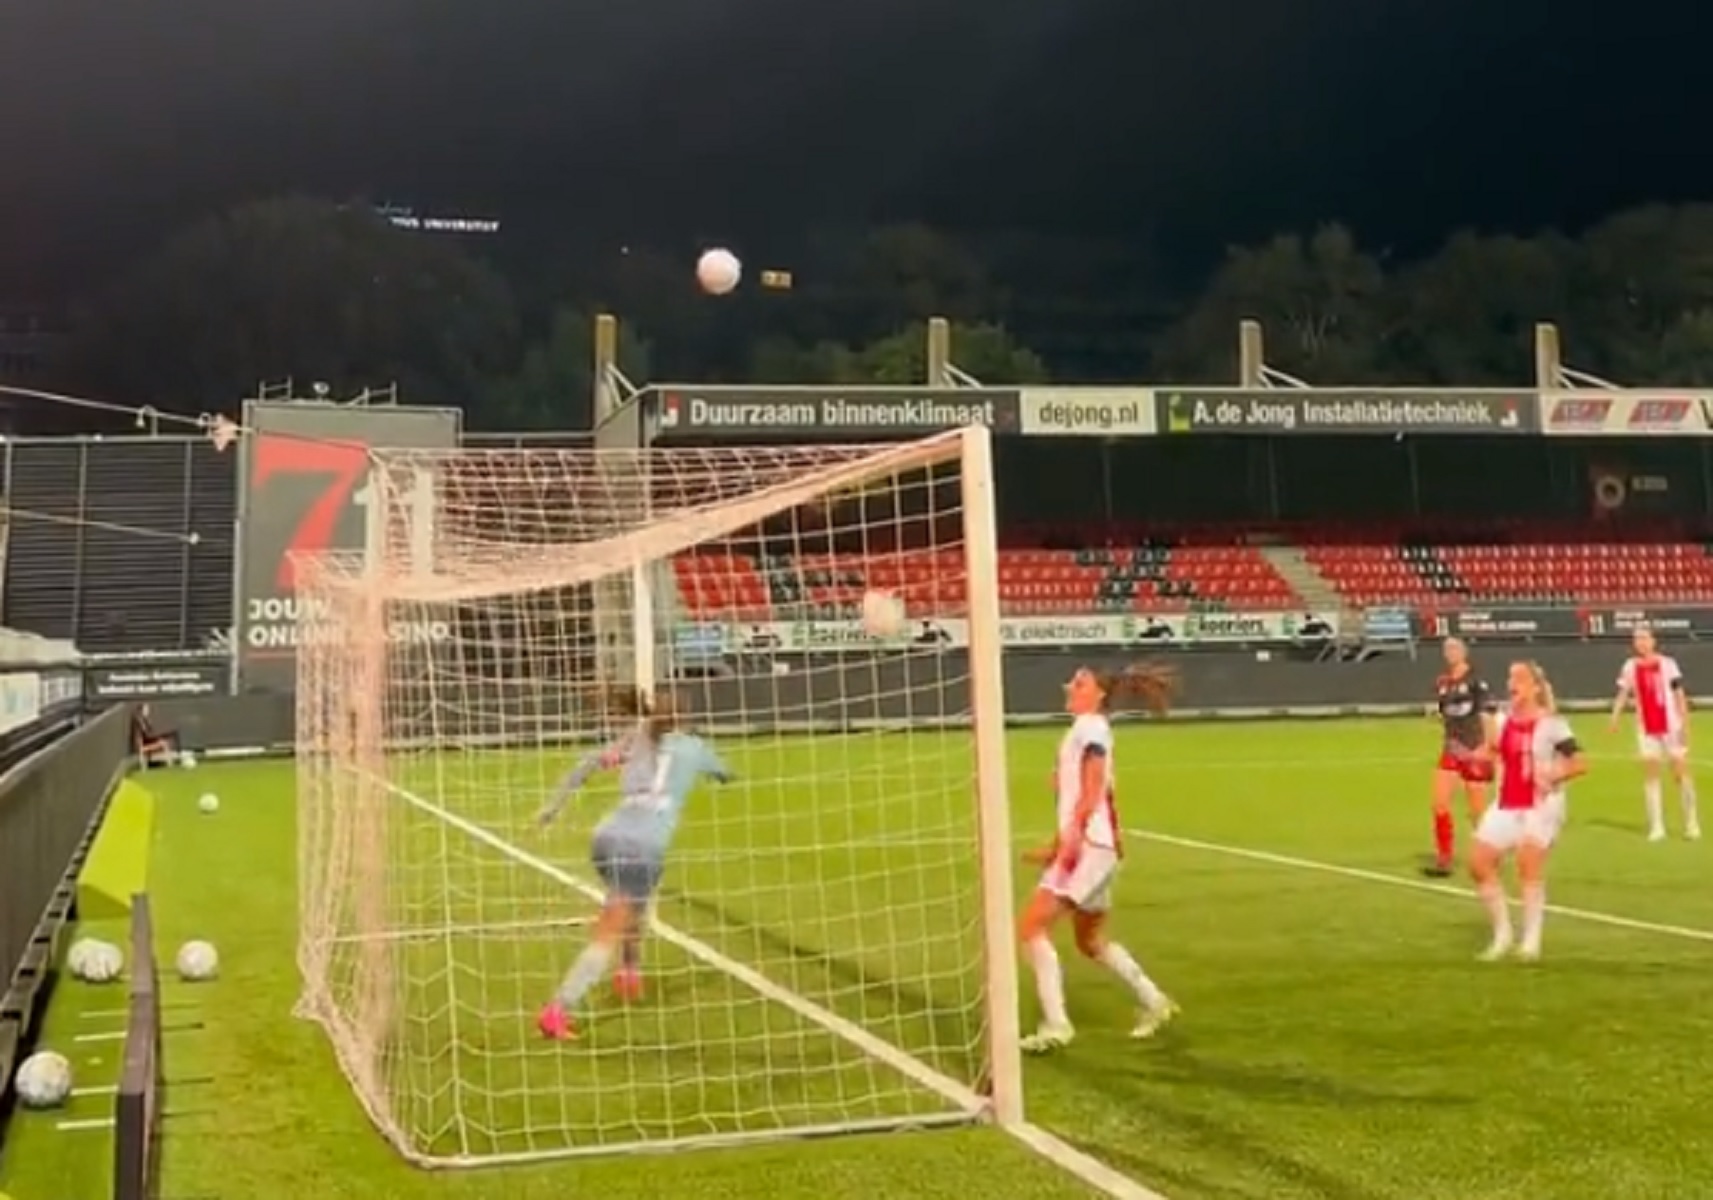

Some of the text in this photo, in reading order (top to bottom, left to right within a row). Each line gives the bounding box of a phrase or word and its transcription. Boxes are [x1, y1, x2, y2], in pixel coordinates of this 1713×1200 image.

[689, 399, 995, 427] Duurzaam binnenklimaat
[1039, 402, 1138, 428] dejong.nl
[1246, 400, 1296, 429] Jong
